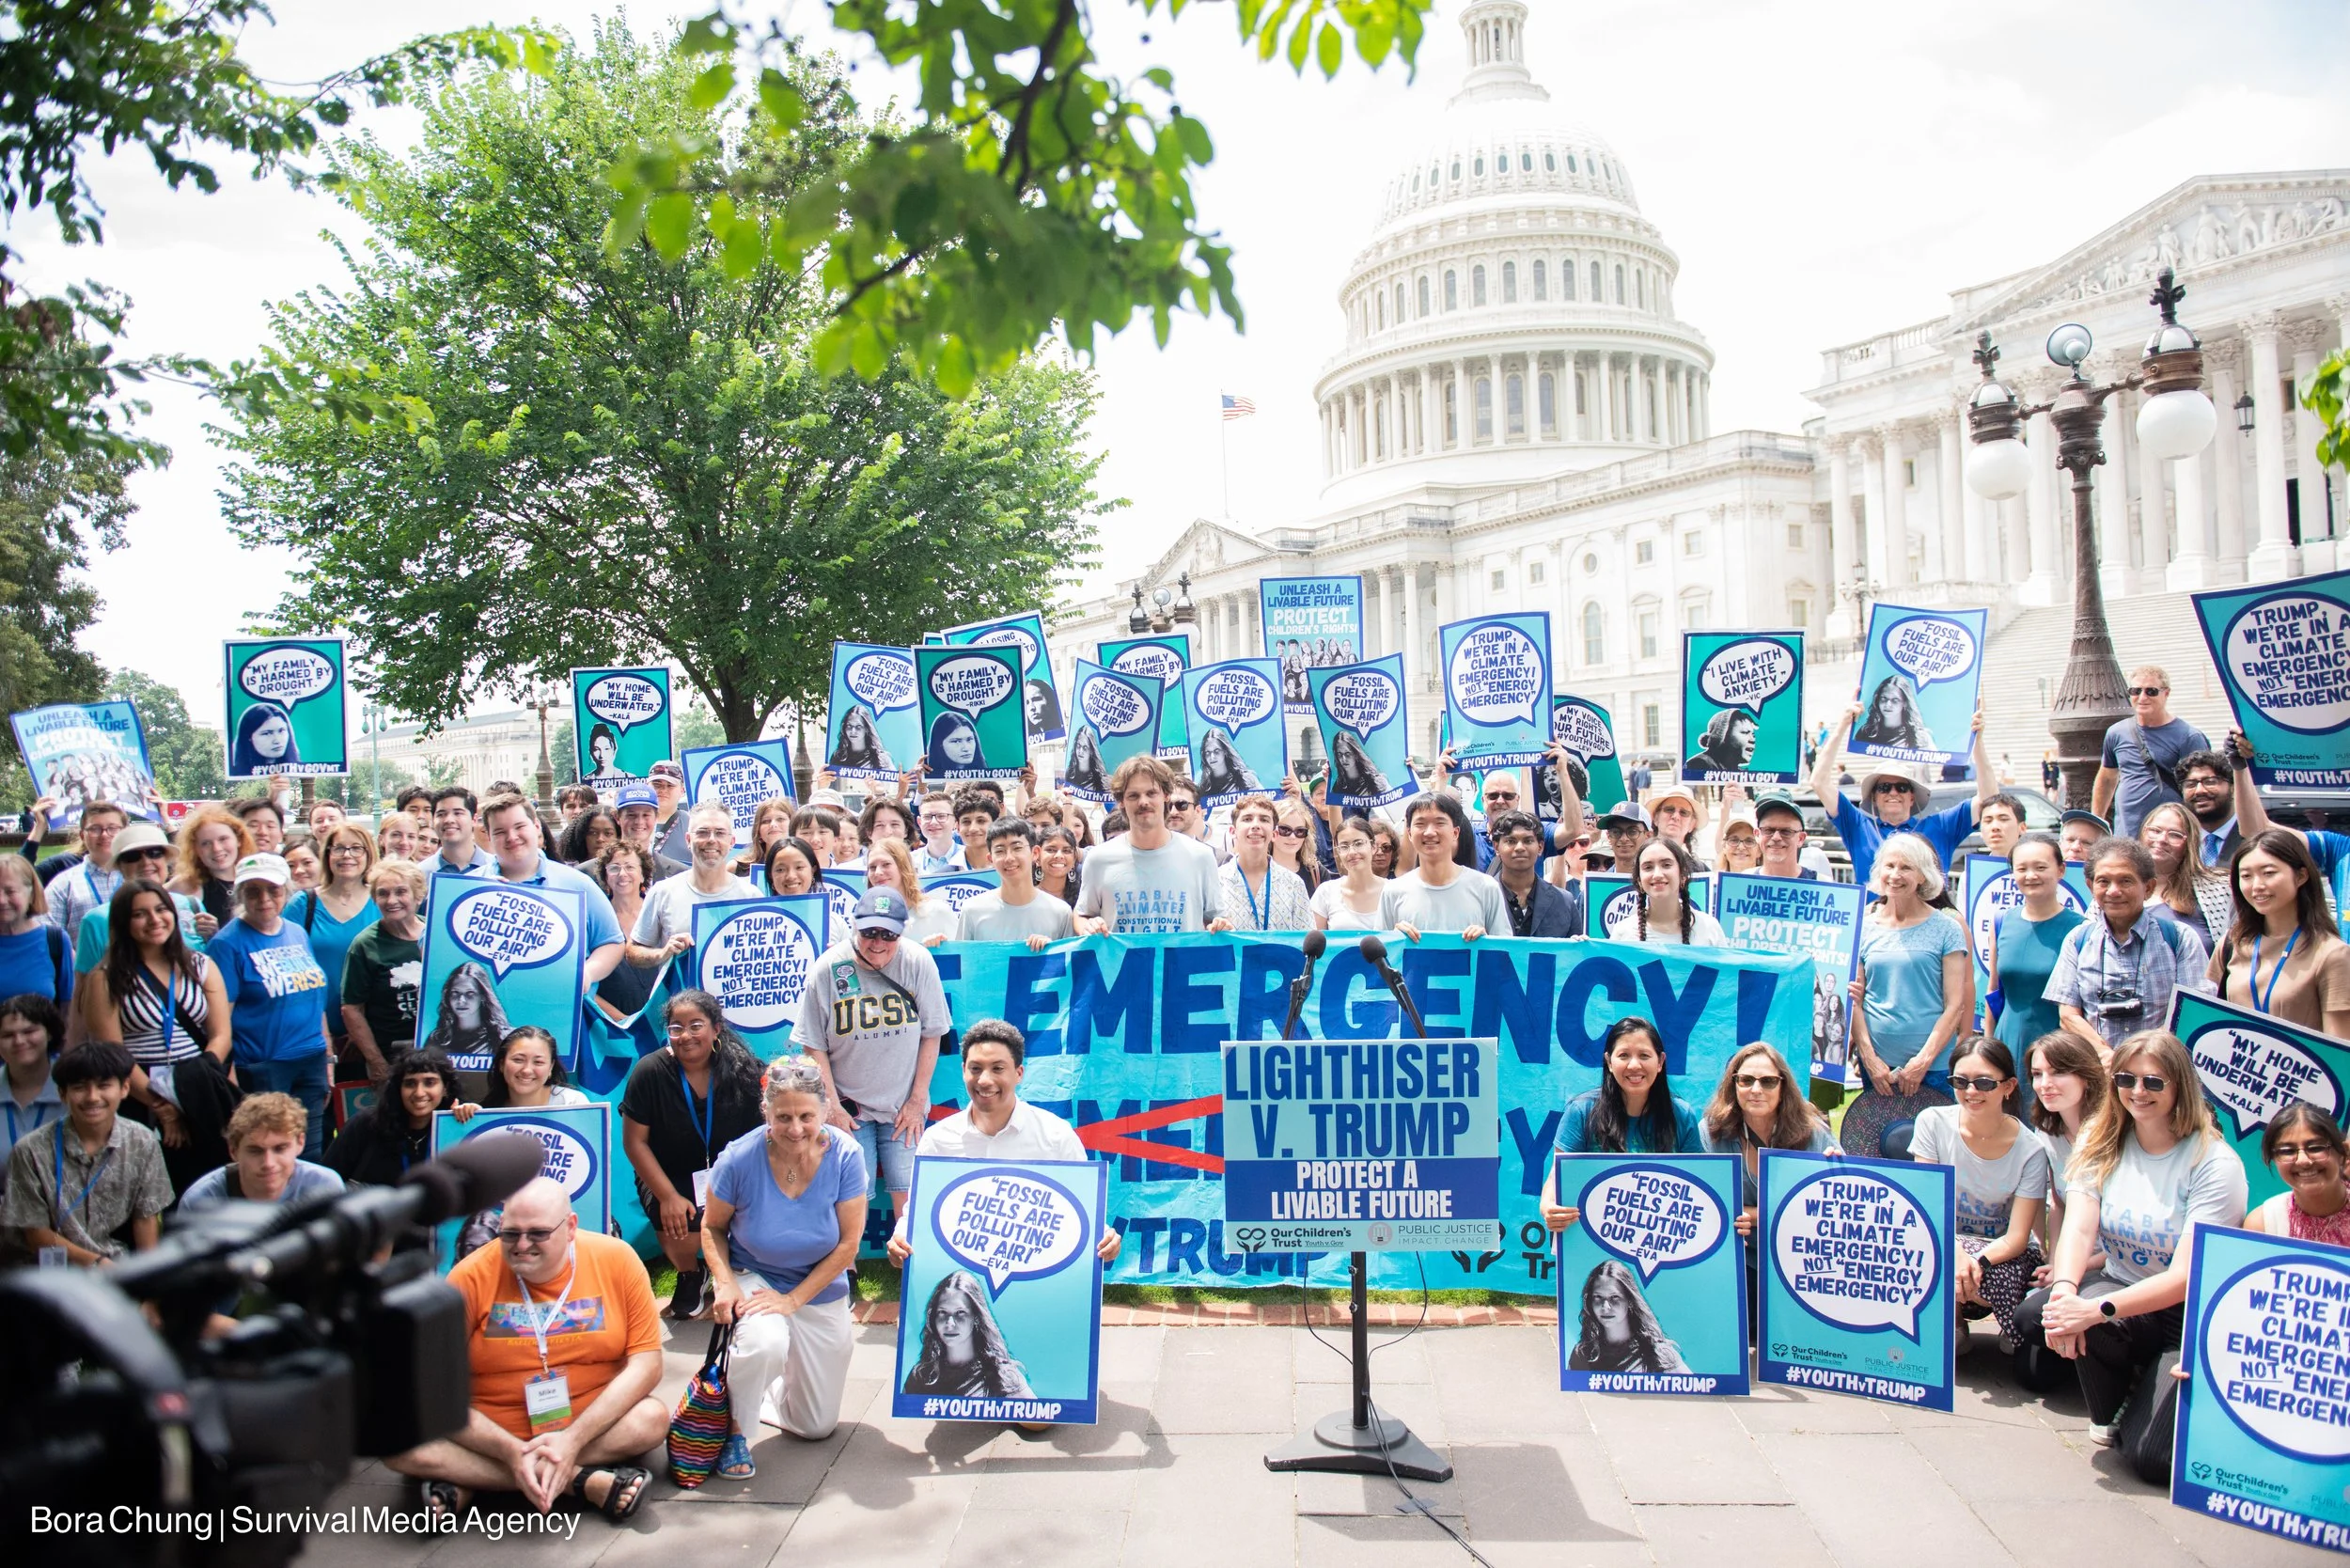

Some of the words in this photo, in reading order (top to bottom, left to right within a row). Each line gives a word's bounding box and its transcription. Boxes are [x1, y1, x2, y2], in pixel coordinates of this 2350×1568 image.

[1279, 584, 1330, 596] UNLEASH
[1334, 584, 1341, 594] A
[1267, 595, 1310, 608] LIVABLE
[1314, 594, 1354, 606] FUTURE
[1274, 607, 1350, 625] PROTECT
[2250, 602, 2327, 626] TRUMP,
[1267, 624, 1319, 635] CHILDREN'S
[1470, 630, 1517, 645] TRUMP,
[2243, 622, 2302, 644] WE'RE
[2309, 618, 2329, 635] IN
[1464, 644, 1499, 660] WE'RE
[1504, 642, 1517, 654] IN
[1522, 641, 1530, 653] A
[1902, 628, 1940, 648] FUELS
[1944, 640, 1966, 654] ARE
[2260, 633, 2346, 659] CLIMATE
[1135, 653, 1169, 666] FAMILY
[1471, 654, 1525, 670] CLIMATE
[1718, 658, 1745, 675] LIVE
[1750, 648, 1781, 666] WITH
[1894, 651, 1919, 666] OUR
[1898, 639, 1960, 666] POLLUTING
[274, 658, 317, 670] FAMILY
[958, 666, 998, 680] FAMILY
[1169, 660, 1181, 670] BY
[246, 676, 256, 686] IS
[261, 670, 311, 683] HARMED
[317, 666, 331, 677] BY
[861, 663, 891, 681] FUELS
[893, 674, 915, 687] ARE
[935, 682, 945, 694] IS
[948, 677, 993, 692] HARMED
[998, 673, 1011, 685] BY
[1458, 666, 1536, 686] EMERGENCY!
[1721, 662, 1778, 687] CLIMATE
[2257, 676, 2284, 691] NOT
[625, 683, 651, 693] HOME
[854, 682, 874, 697] OUR
[857, 673, 910, 697] POLLUTING
[1208, 684, 1239, 695] FUELS
[1243, 687, 1264, 698] ARE
[1334, 687, 1368, 698] FUELS
[1371, 688, 1390, 699] ARE
[1465, 684, 1483, 696] NOT
[608, 691, 628, 701] WILL
[632, 692, 644, 702] BE
[1090, 684, 1115, 705] FUELS
[1117, 698, 1140, 713] ARE
[1207, 694, 1261, 708] POLLUTING
[1334, 698, 1388, 711] POLLUTING
[38, 711, 98, 724] UNLEASH
[104, 710, 113, 720] A
[1086, 704, 1100, 721] OUR
[1089, 694, 1135, 722] POLLUTING
[1206, 705, 1225, 715] OUR
[1334, 707, 1355, 720] OUR
[1566, 707, 1579, 716] MY
[24, 719, 78, 737] LIVABLE
[83, 719, 130, 732] FUTURE
[1559, 713, 1573, 724] MY
[716, 759, 759, 771] TRUMP,
[710, 771, 744, 785] WE'RE
[747, 766, 760, 779] IN
[763, 768, 772, 778] A
[719, 779, 767, 796] CLIMATE
[1115, 890, 1186, 902] STABLE
[1747, 885, 1820, 906] UNLEASH
[1825, 893, 1835, 908] A
[472, 902, 520, 925] FUELS
[522, 918, 555, 934] ARE
[1117, 902, 1178, 915] CLIMATE
[1727, 898, 1789, 918] LIVABLE
[1794, 905, 1851, 926] FUTURE
[468, 916, 547, 947] POLLUTING
[734, 917, 787, 933] TRUMP,
[1733, 917, 1842, 951] PROTECT
[463, 931, 494, 950] OUR
[724, 932, 768, 949] WE'RE
[773, 931, 787, 944] IN
[793, 930, 803, 942] A
[731, 945, 794, 963] CLIMATE
[713, 959, 807, 980] EMERGENCY!
[721, 978, 745, 993] NOT
[854, 1027, 907, 1041] ALUMNI
[1226, 1043, 1480, 1101] LIGHTHISER
[2230, 1051, 2268, 1081] WILL
[2274, 1073, 2302, 1095] BE
[2265, 1050, 2322, 1085] HOME
[1250, 1104, 1293, 1158] V.
[1308, 1102, 1470, 1157] TRUMP
[1296, 1160, 1396, 1189] PROTECT
[1403, 1160, 1418, 1188] A
[1271, 1191, 1361, 1219] LIVABLE
[1369, 1190, 1452, 1218] FUTURE
[1818, 1181, 1895, 1209] TRUMP,
[963, 1192, 1021, 1220] FUELS
[1024, 1208, 1064, 1231] ARE
[1606, 1188, 1663, 1215] FUELS
[1667, 1201, 1704, 1223] ARE
[1805, 1199, 1870, 1220] WE'RE
[1874, 1206, 1894, 1225] IN
[1902, 1210, 1918, 1228] A
[957, 1211, 1055, 1249] POLLUTING
[1398, 1225, 1440, 1234] PUBLIC
[1444, 1224, 1493, 1233] JUSTICE
[1603, 1205, 1698, 1240] POLLUTING
[951, 1229, 989, 1252] OUR
[1272, 1237, 1302, 1247] Trust
[1445, 1236, 1490, 1245] CHANGE
[1600, 1221, 1636, 1244] OUR
[1815, 1220, 1905, 1246] CLIMATE
[1792, 1236, 1924, 1267] EMERGENCY!
[1803, 1255, 1833, 1275] NOT
[2249, 1289, 2328, 1323] WE'RE
[1793, 1353, 1812, 1361] Trust
[2241, 1361, 2283, 1383] NOT
[2216, 1476, 2243, 1491] Trust
